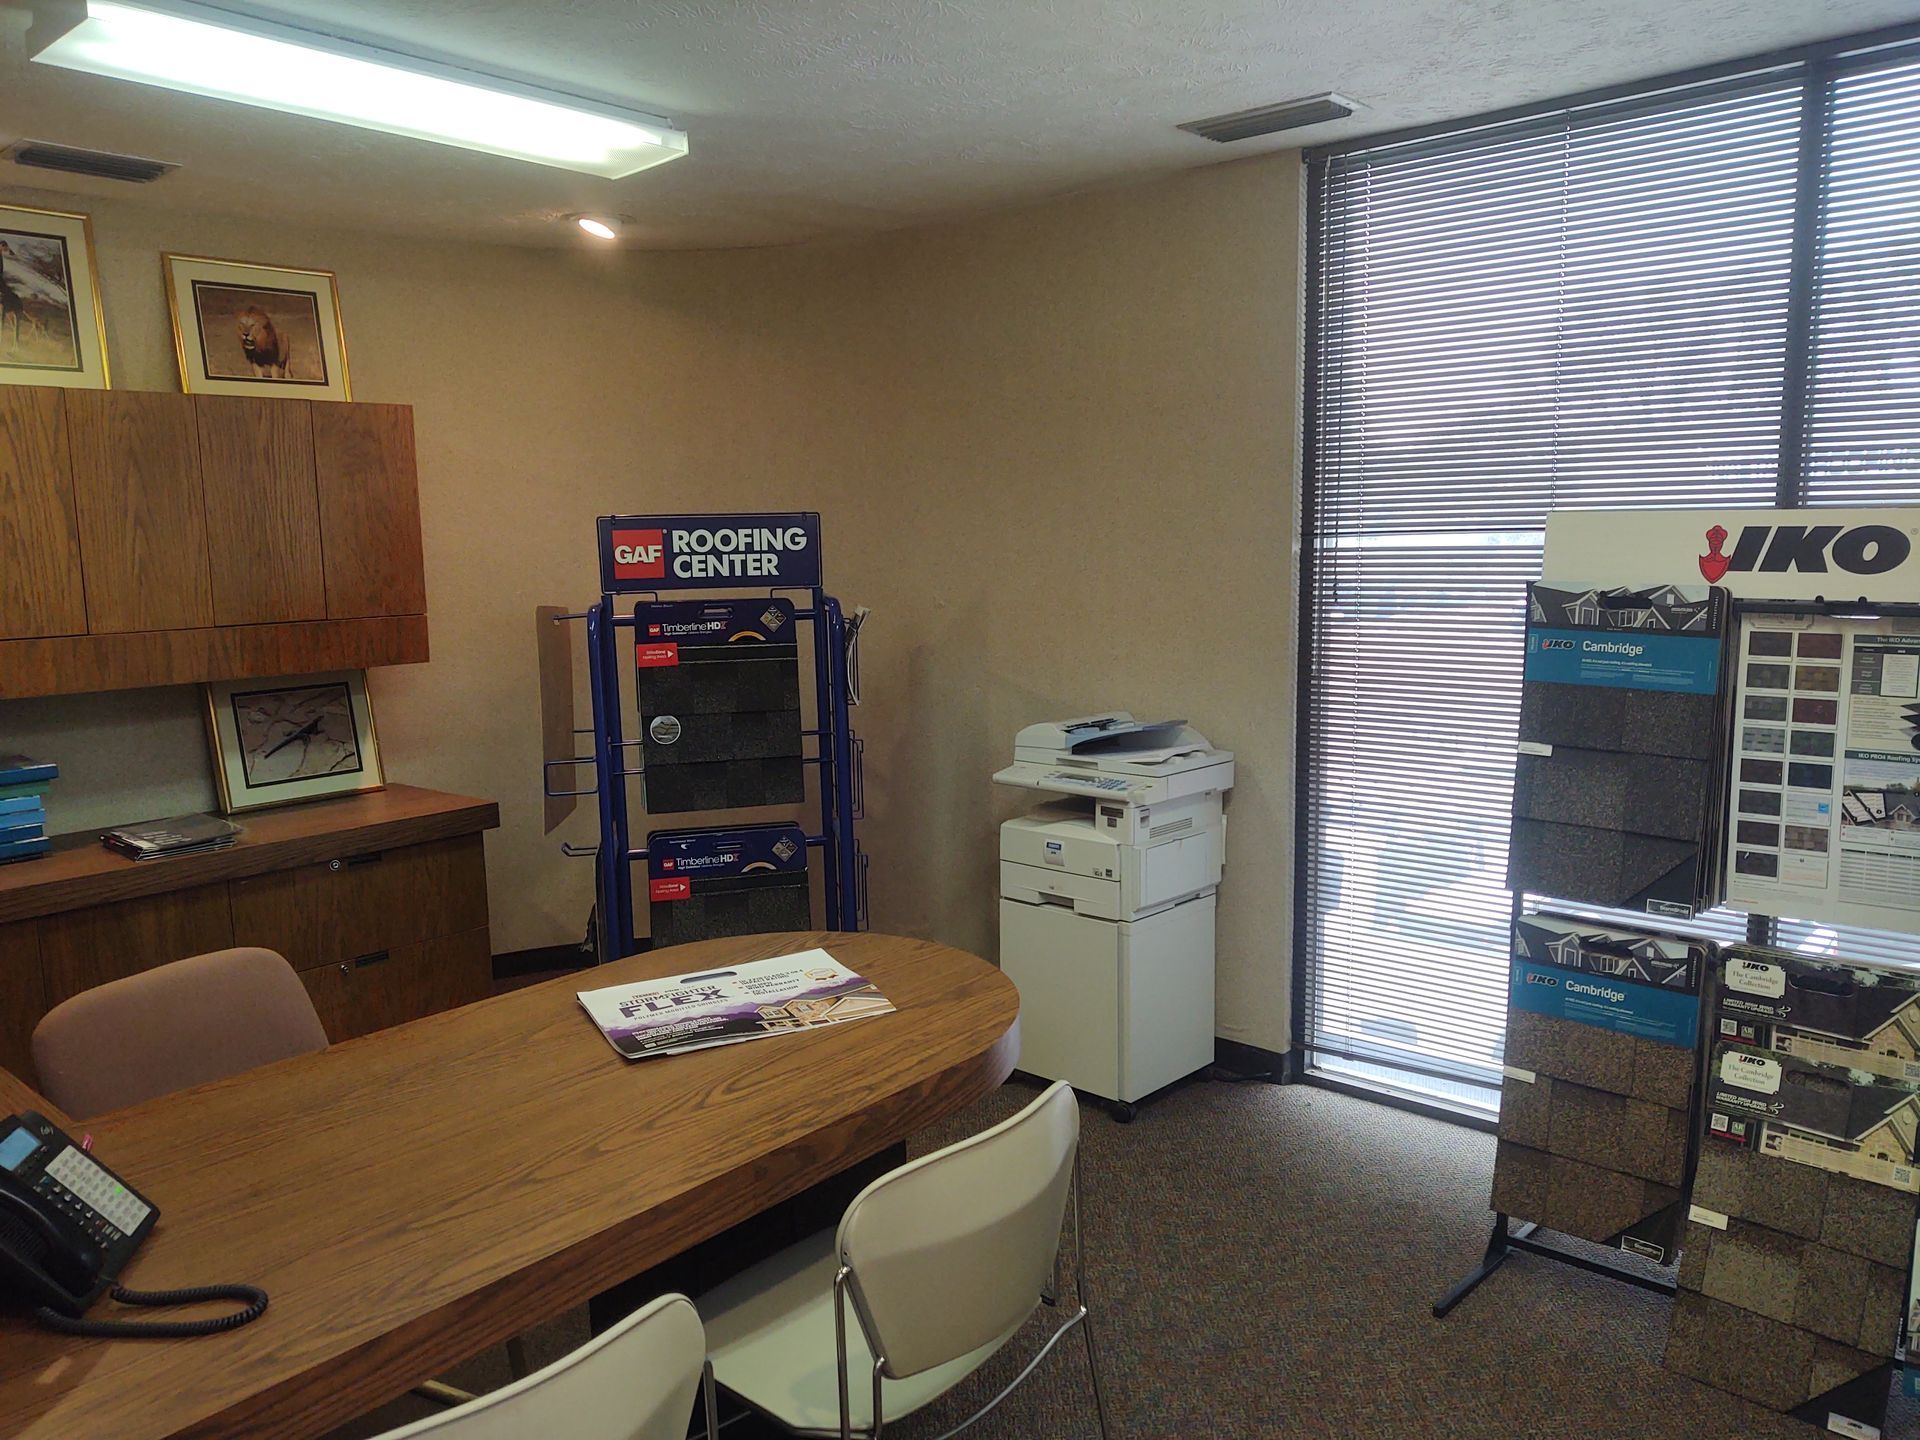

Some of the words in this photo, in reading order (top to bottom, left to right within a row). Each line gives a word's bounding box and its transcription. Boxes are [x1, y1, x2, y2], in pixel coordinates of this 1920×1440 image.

[672, 527, 807, 553] ROOFING
[614, 544, 662, 564] GAF
[1727, 525, 1911, 574] IKO
[673, 553, 780, 578] CENTER
[662, 622, 707, 632] Timberline
[1547, 639, 1576, 650] IKO
[1582, 640, 1643, 656] Cambridge
[675, 855, 720, 866] Timberline
[1743, 962, 1769, 972] IKO
[1531, 974, 1559, 987] IKO
[1739, 980, 1771, 990] Collection
[1745, 973, 1778, 985] Cambridge
[619, 985, 717, 1007] STORMFIGHTER
[1565, 981, 1625, 1002] Cambridge
[619, 989, 730, 1019] FLEX
[1741, 1055, 1766, 1066] IKO
[1734, 1073, 1766, 1085] Collection
[1741, 1067, 1774, 1080] Cambridge
